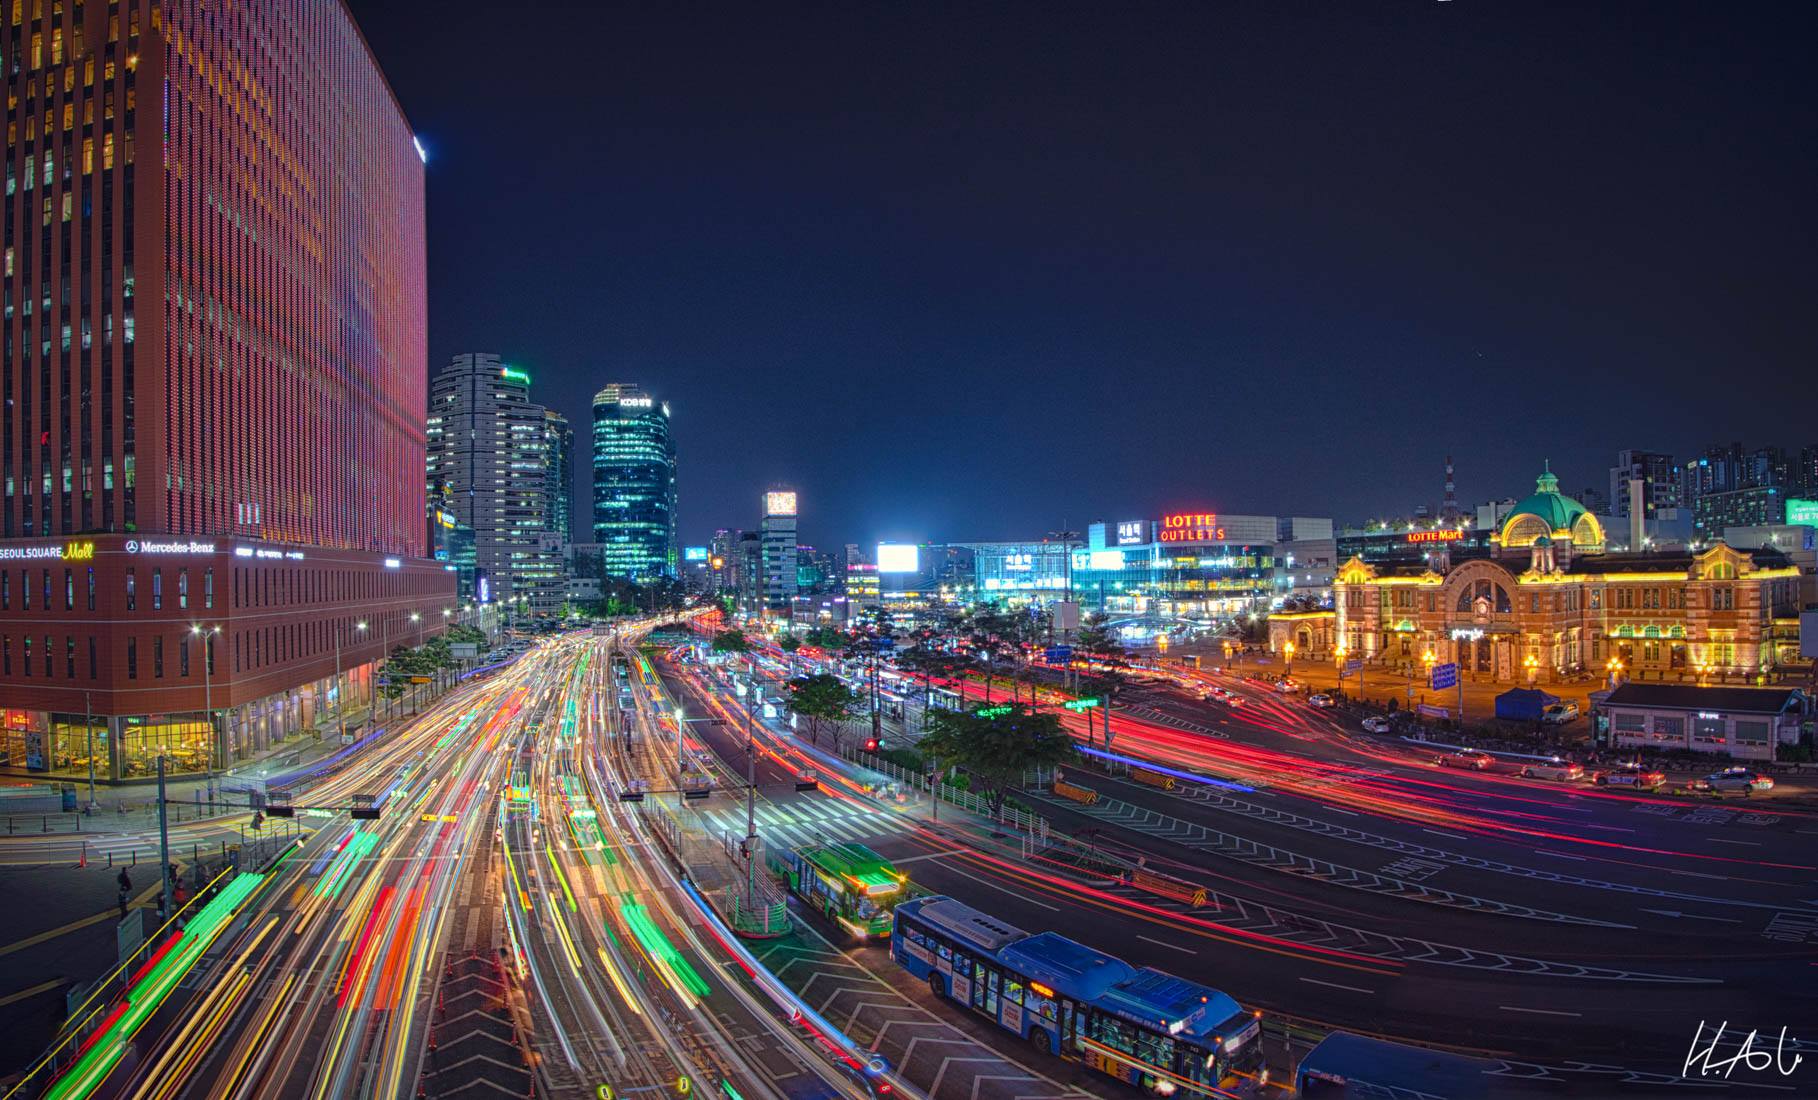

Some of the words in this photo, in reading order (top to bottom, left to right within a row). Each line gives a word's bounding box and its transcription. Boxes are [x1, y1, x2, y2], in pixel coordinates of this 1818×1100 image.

[1165, 514, 1216, 528] LOTTE
[1160, 528, 1225, 541] OUTLETS
[1408, 532, 1437, 542] LOTTE
[1438, 530, 1463, 540] Mart
[0, 547, 62, 559] SEOULSQUARE
[62, 543, 94, 560] Mall
[141, 541, 214, 553] Mercedes-Benz
